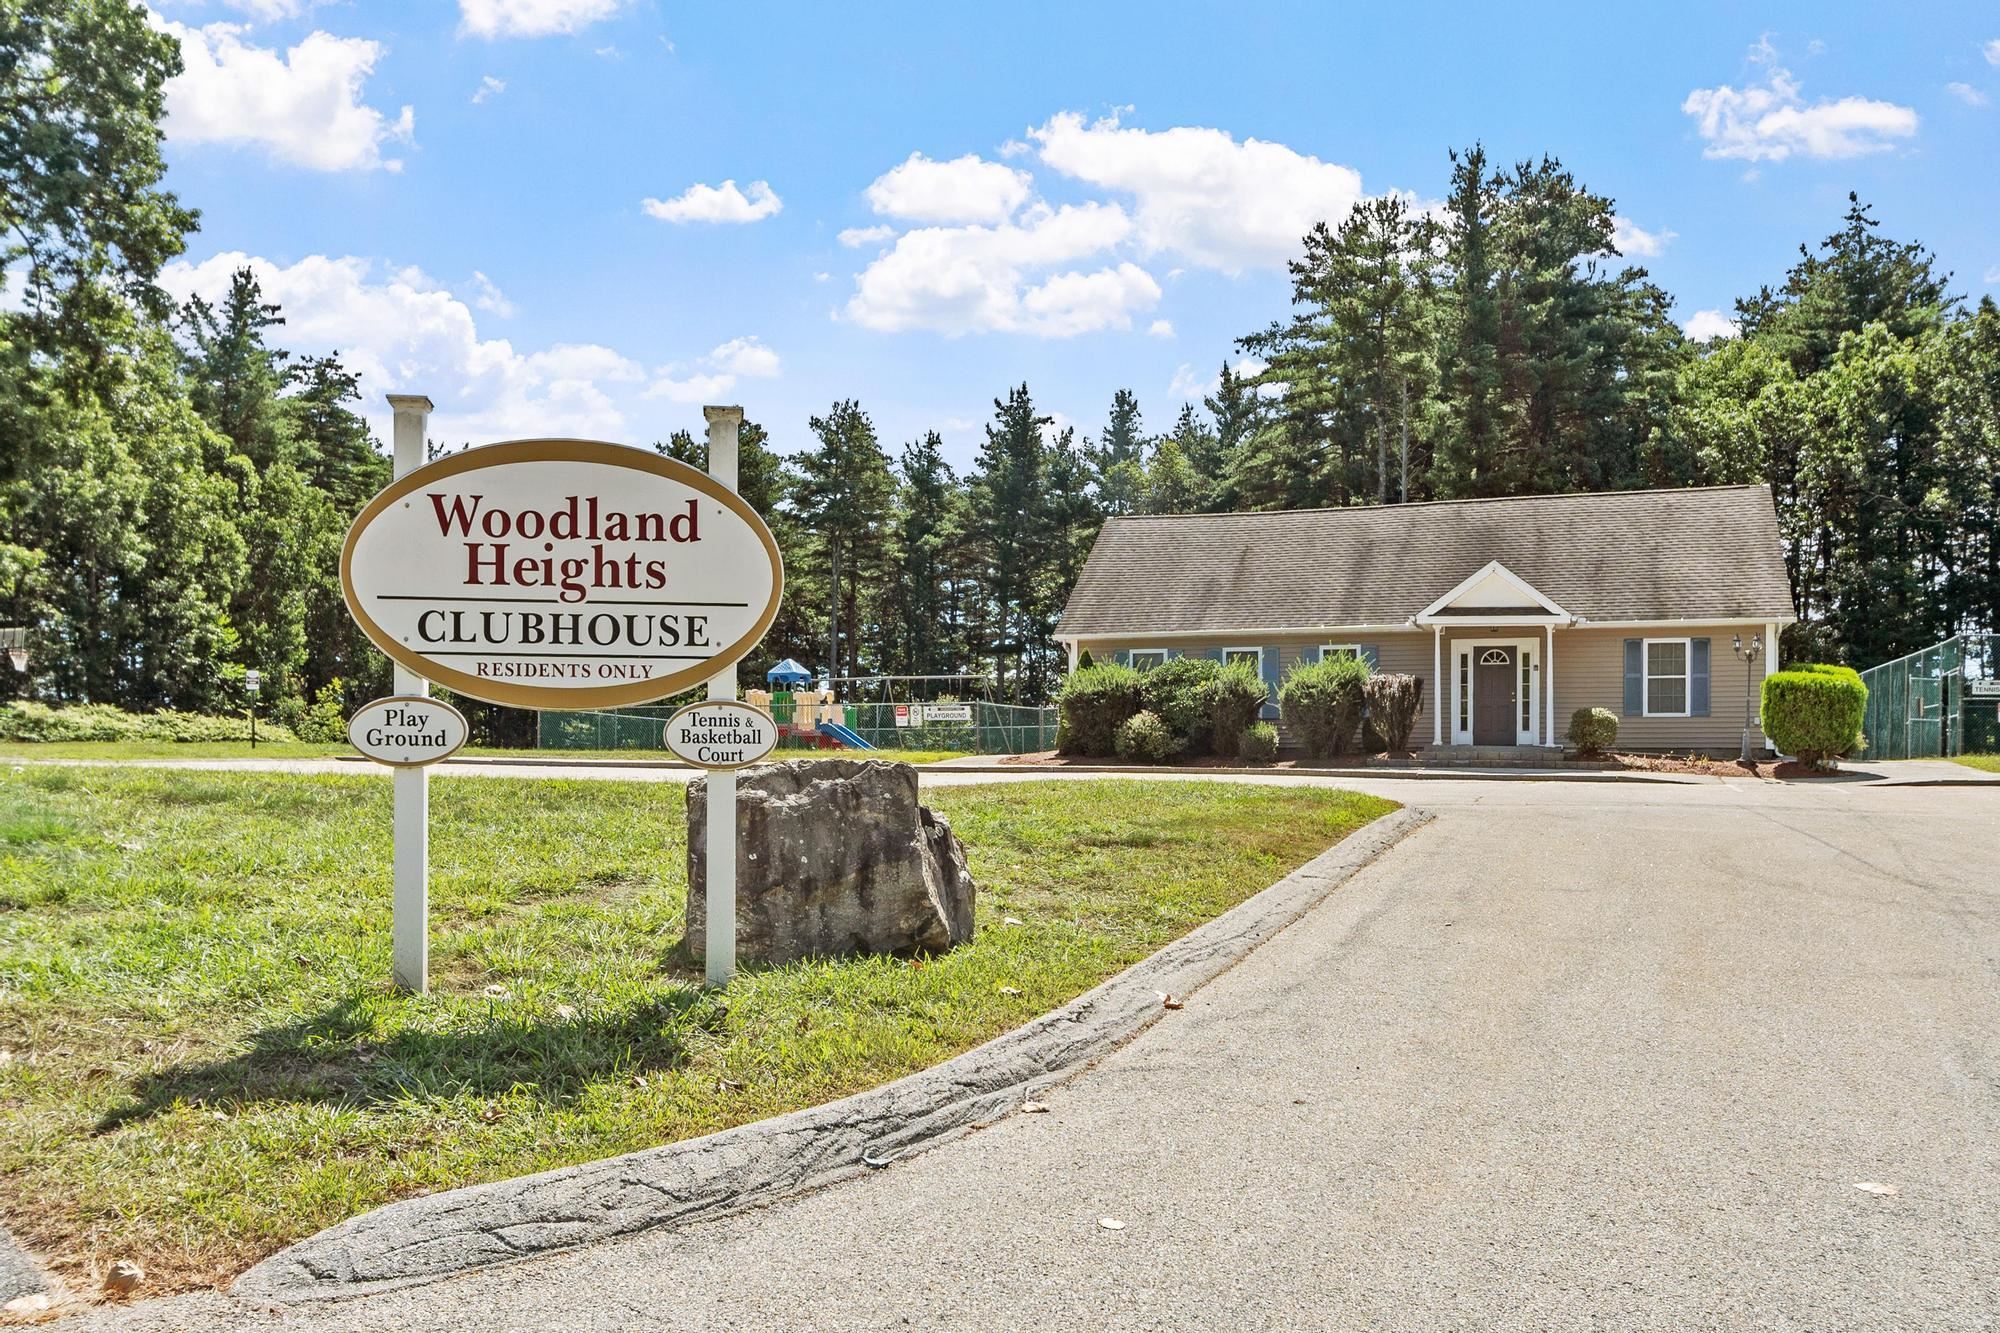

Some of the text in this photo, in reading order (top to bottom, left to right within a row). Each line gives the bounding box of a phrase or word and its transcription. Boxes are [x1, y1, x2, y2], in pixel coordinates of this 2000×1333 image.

[427, 493, 702, 542] Woodland
[462, 542, 667, 603] Heights
[417, 609, 710, 647] CLUBHOUSE
[476, 662, 654, 679] RESIDENTS ONLY
[384, 709, 430, 733] Play
[689, 712, 754, 728] Tennis &
[366, 728, 447, 747] Ground
[680, 728, 762, 745] Basketball
[697, 746, 744, 763] Court
